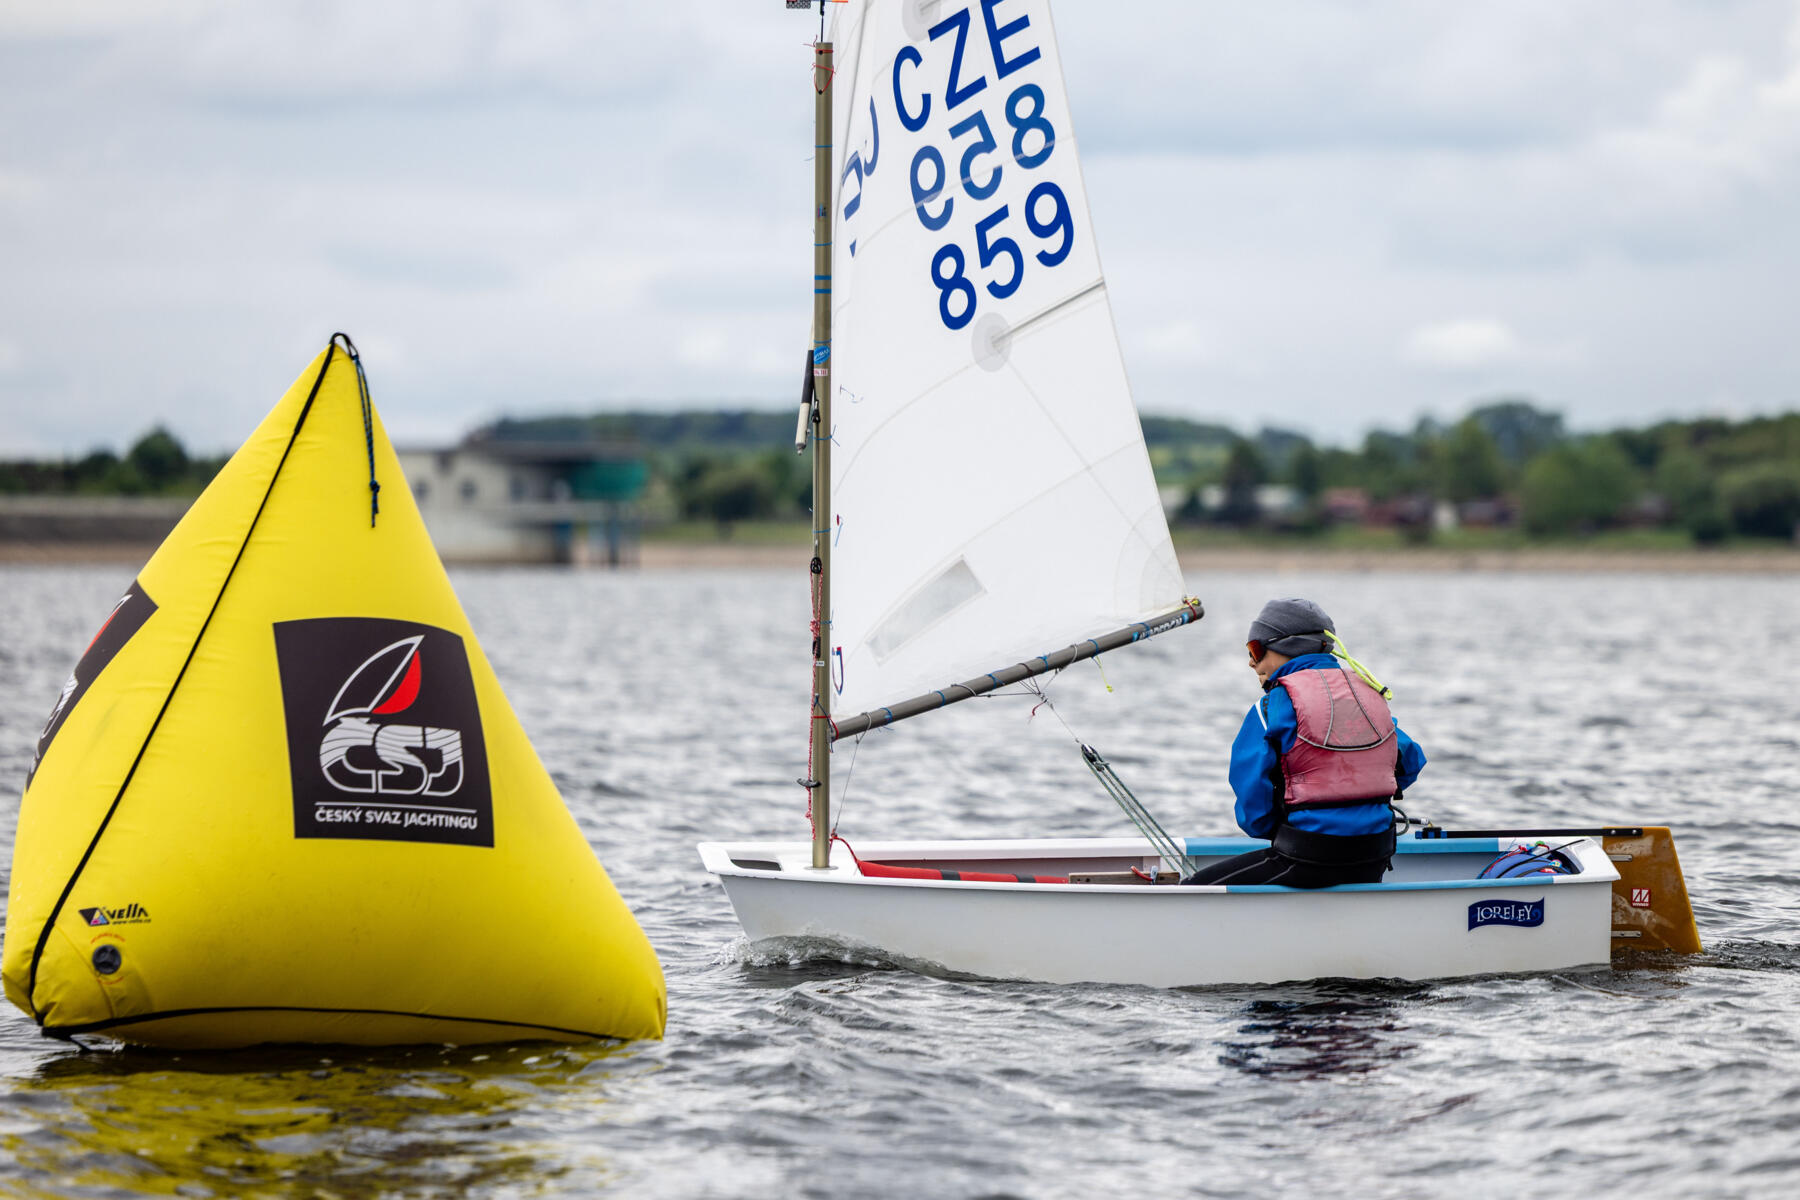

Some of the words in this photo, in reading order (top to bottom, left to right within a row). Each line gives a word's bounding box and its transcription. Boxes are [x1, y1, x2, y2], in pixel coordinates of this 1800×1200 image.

[892, 0, 1042, 133] CZE
[930, 181, 1075, 331] 859
[314, 806, 361, 822] ČESKÝ
[365, 809, 402, 825] SVAZ
[404, 812, 478, 830] JACHTINGU
[1476, 904, 1533, 922] LORELEY
